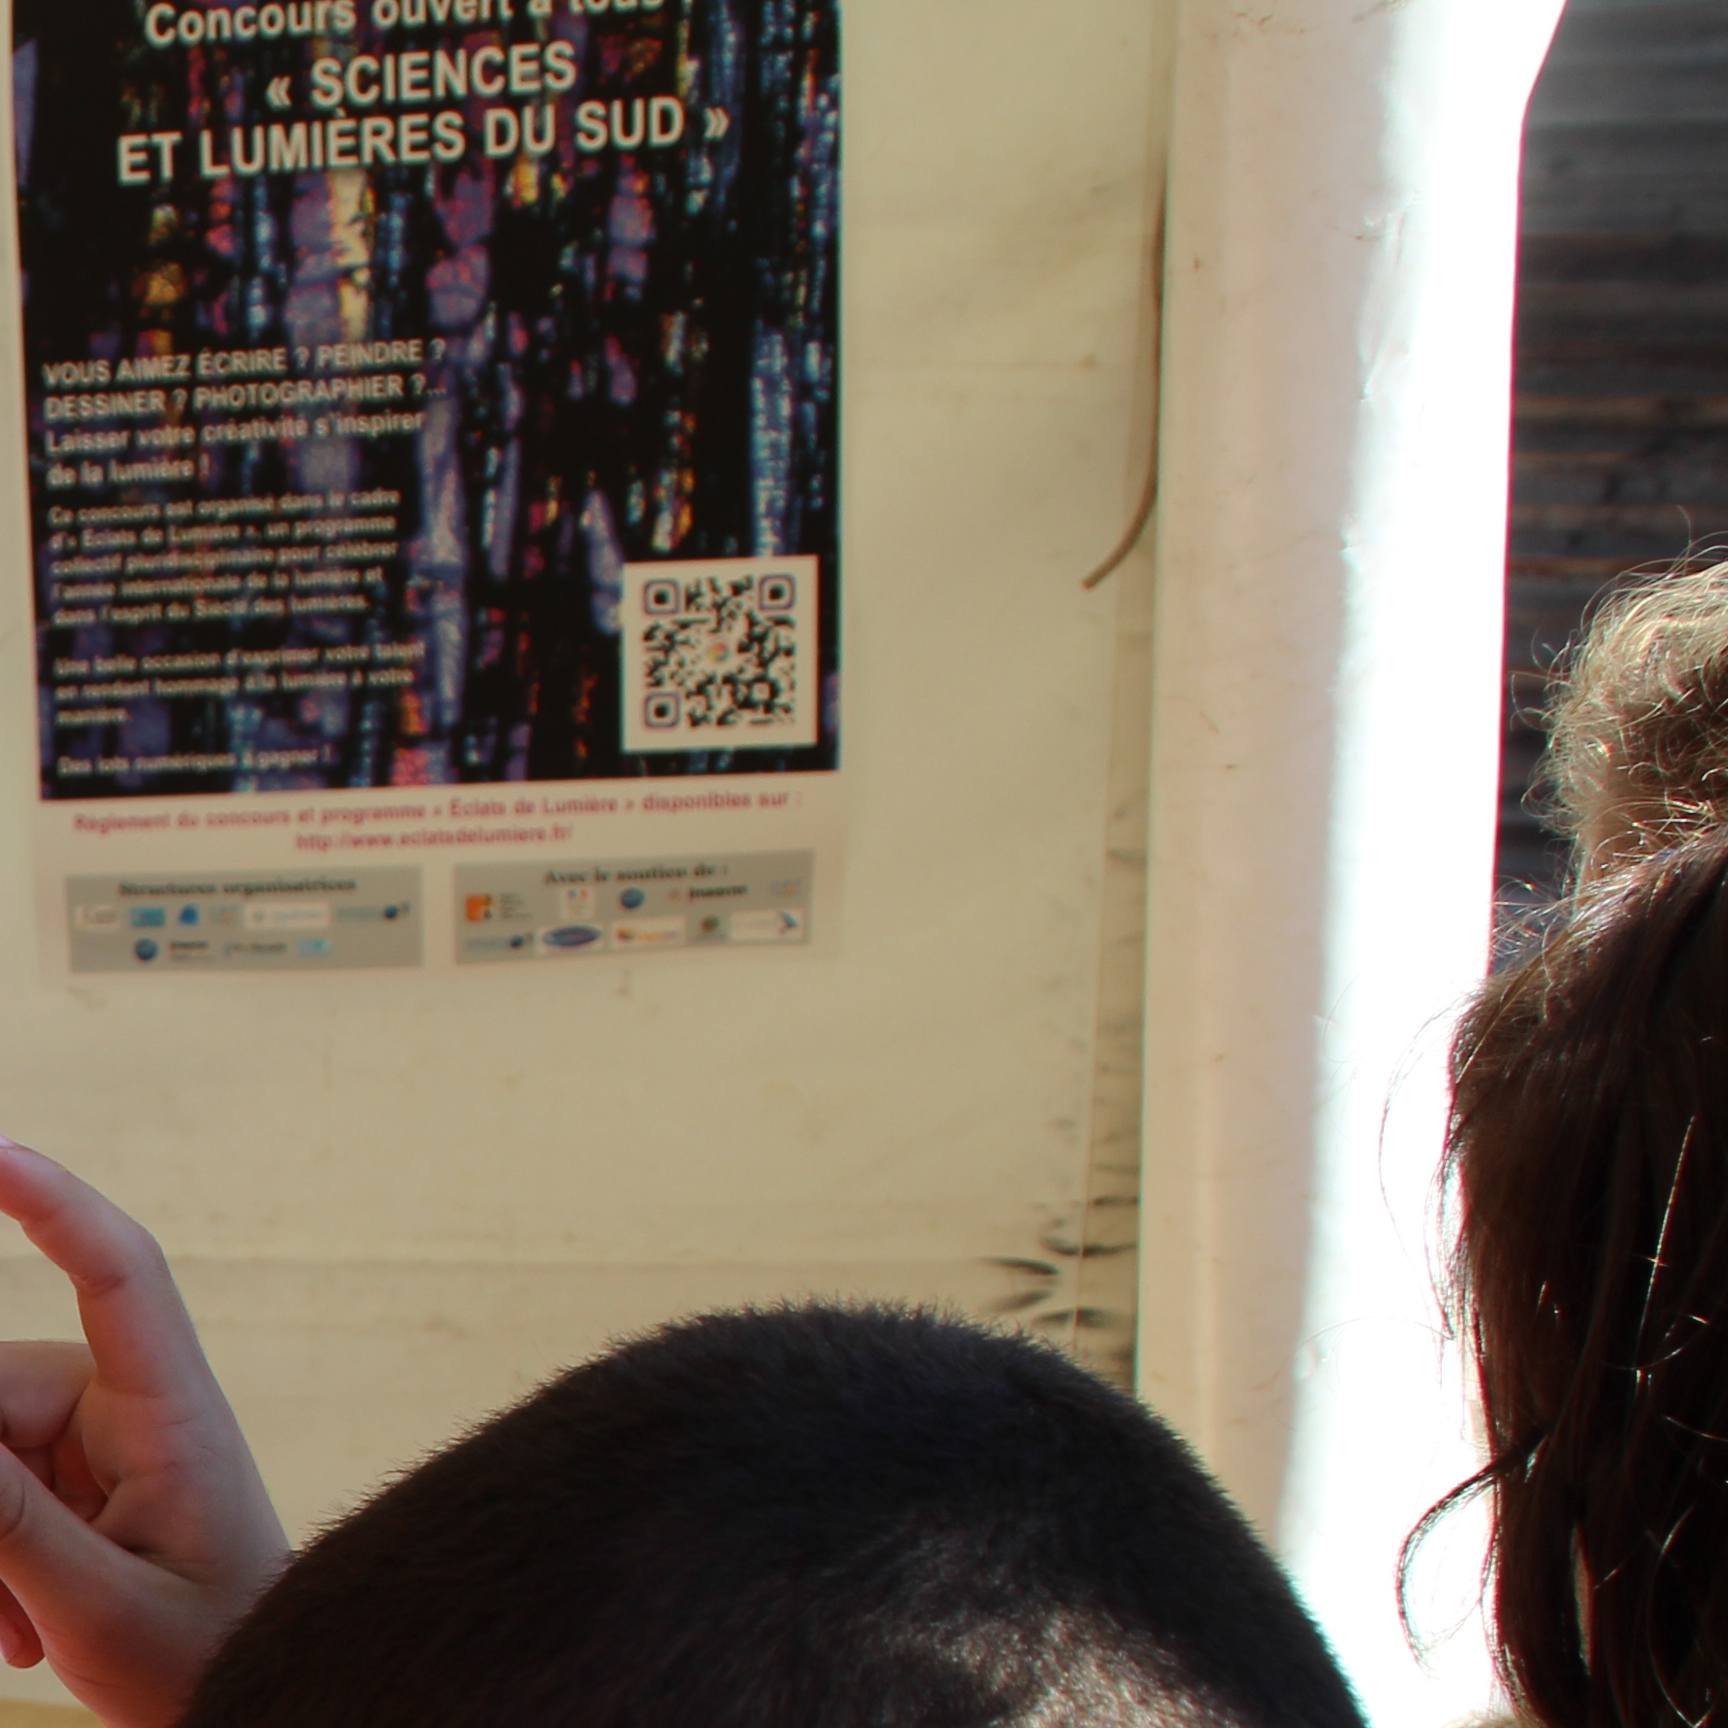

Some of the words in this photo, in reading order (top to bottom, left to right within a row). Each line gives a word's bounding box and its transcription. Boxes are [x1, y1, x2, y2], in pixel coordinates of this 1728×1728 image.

[145, 0, 358, 46] Concours
[310, 39, 578, 107] SCIENCES
[117, 131, 183, 186] ET
[199, 106, 467, 179] LUMIÈRES
[484, 103, 556, 158] DU
[576, 96, 686, 151] SUD
[44, 360, 111, 388] VOUS
[115, 353, 192, 383] AIMEZ
[196, 347, 287, 380] ÉCRIRE
[295, 347, 310, 368] ?
[314, 339, 424, 368] PEINDRE
[429, 338, 445, 361] ?
[44, 389, 166, 420] DESSINER
[172, 387, 187, 411] ?
[193, 375, 403, 411] PHOTOGRAPHIER
[45, 428, 129, 454] Laisser
[137, 423, 196, 447] votre
[201, 412, 308, 443] créativité
[48, 464, 76, 488] de
[81, 461, 104, 485] la
[108, 456, 195, 483] lumière
[48, 505, 73, 527] Ce
[77, 503, 161, 525] concours
[165, 500, 193, 520] est
[349, 488, 401, 507] cadre
[294, 517, 396, 541] programme
[93, 654, 137, 674] belle
[141, 651, 222, 673] occasion
[324, 644, 370, 664] votre
[153, 676, 239, 699] hommage
[367, 667, 413, 686] votre
[57, 757, 92, 777] Des
[258, 749, 319, 769] gagner
[206, 808, 290, 828] concours
[297, 807, 316, 824] et
[321, 802, 425, 828] programme
[515, 799, 536, 815] de
[544, 795, 618, 814] Lumière
[642, 790, 750, 814] disponibles
[759, 793, 788, 808] sur
[545, 869, 587, 885] Avec
[594, 867, 612, 883] le
[616, 864, 688, 882] soutien
[694, 862, 717, 878] de
